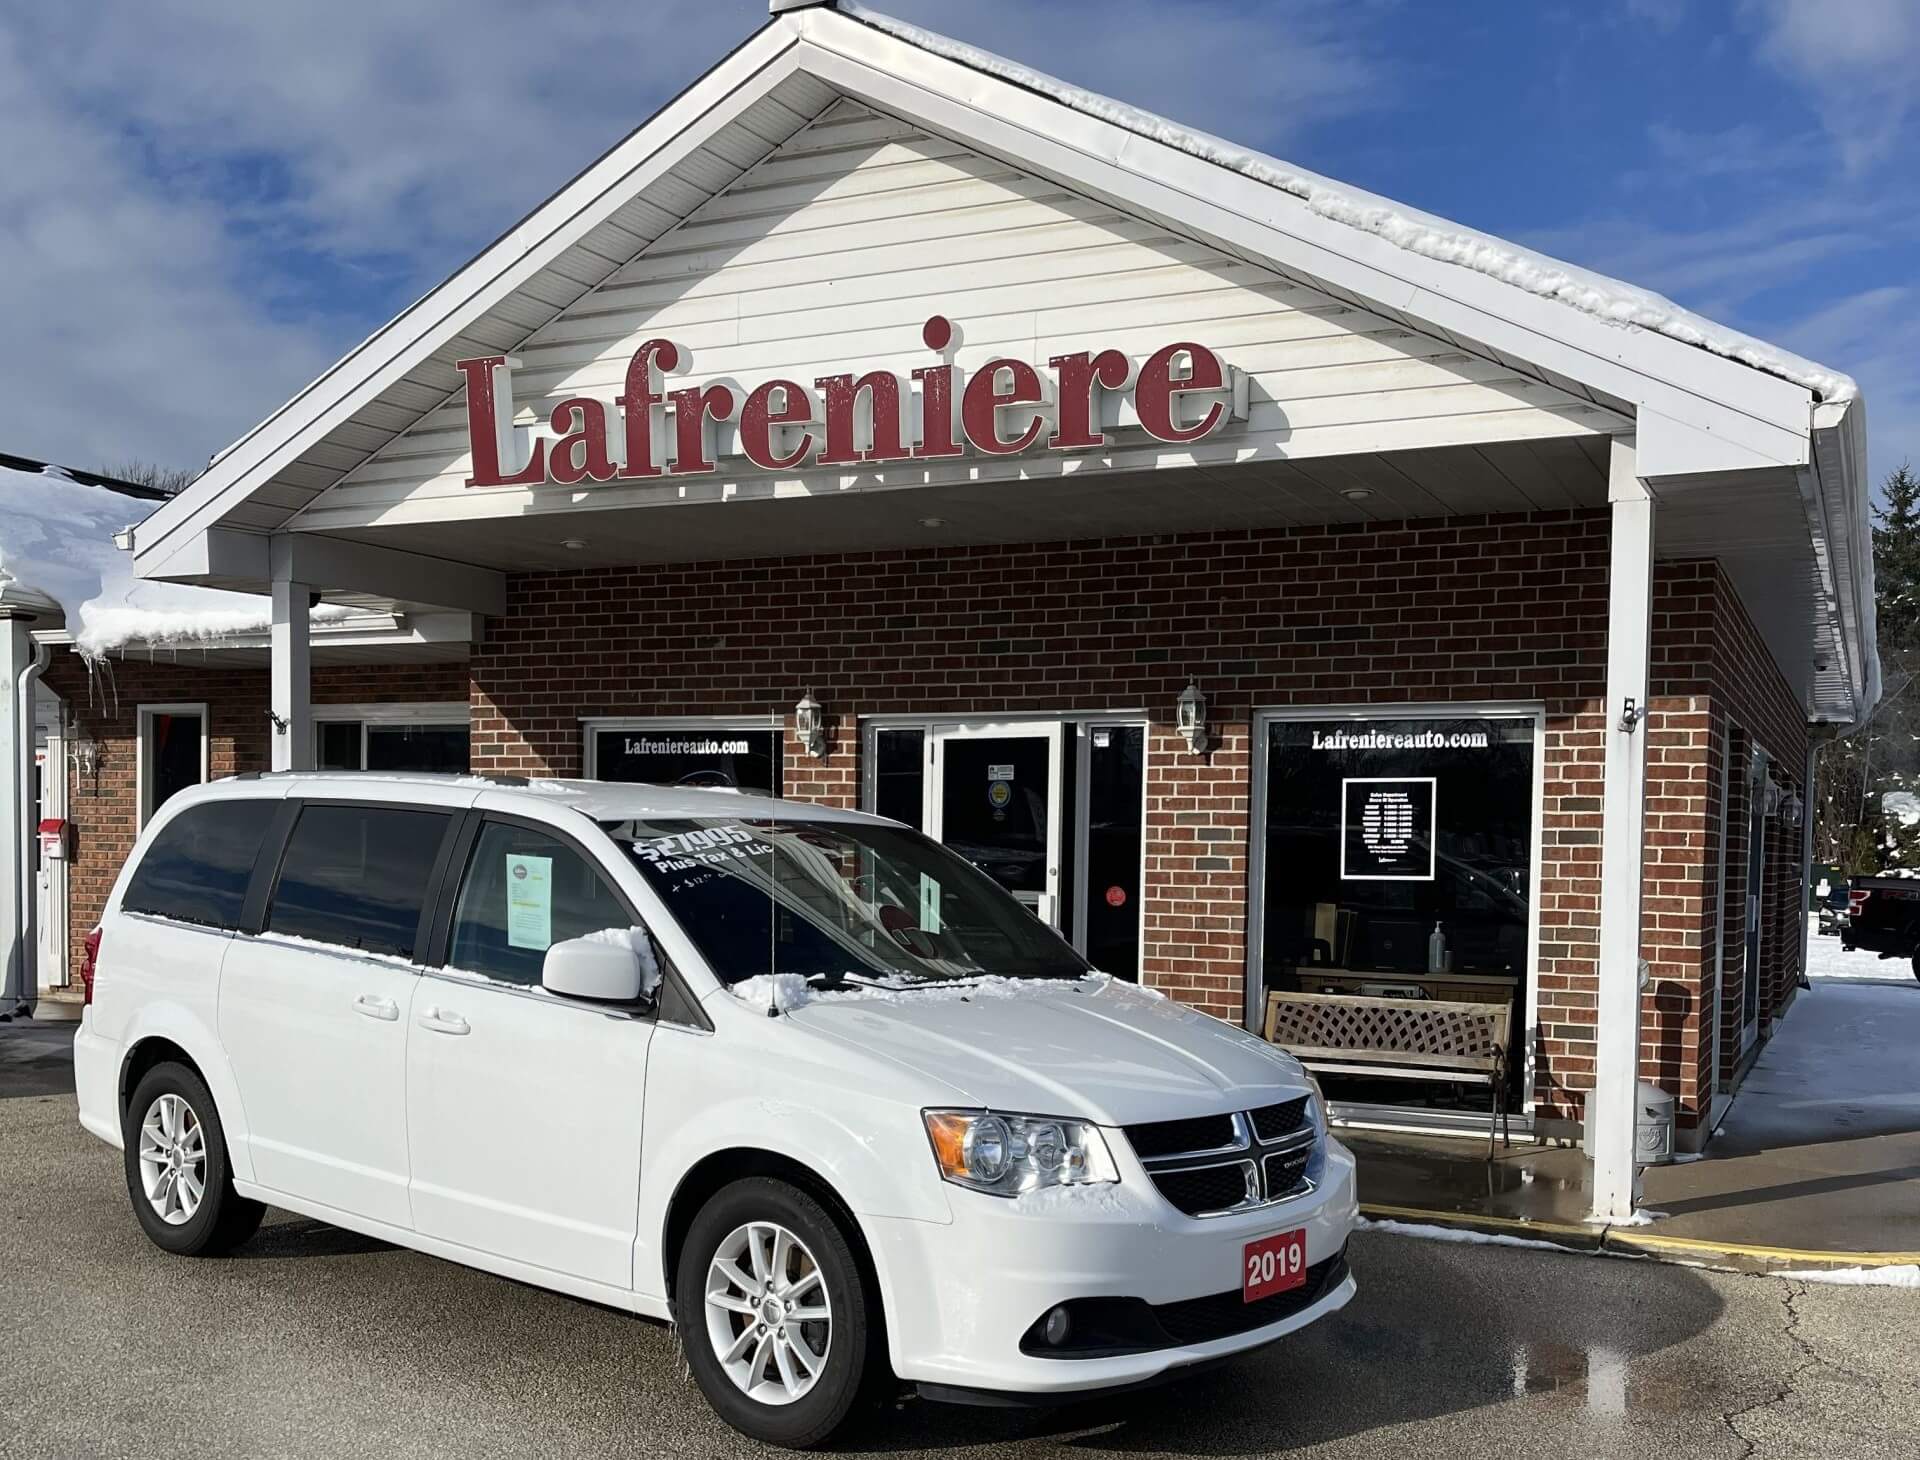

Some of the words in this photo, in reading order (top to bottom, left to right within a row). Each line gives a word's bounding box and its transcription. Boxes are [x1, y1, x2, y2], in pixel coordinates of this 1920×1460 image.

[456, 314, 1233, 488] Lafreniere
[624, 737, 749, 754] Lafreniereauto.com
[1311, 729, 1488, 750] Lafreniereauto.com
[656, 858, 695, 874] Plus
[696, 851, 729, 864] Tax
[731, 847, 746, 858] &
[1247, 1242, 1302, 1287] 2019
